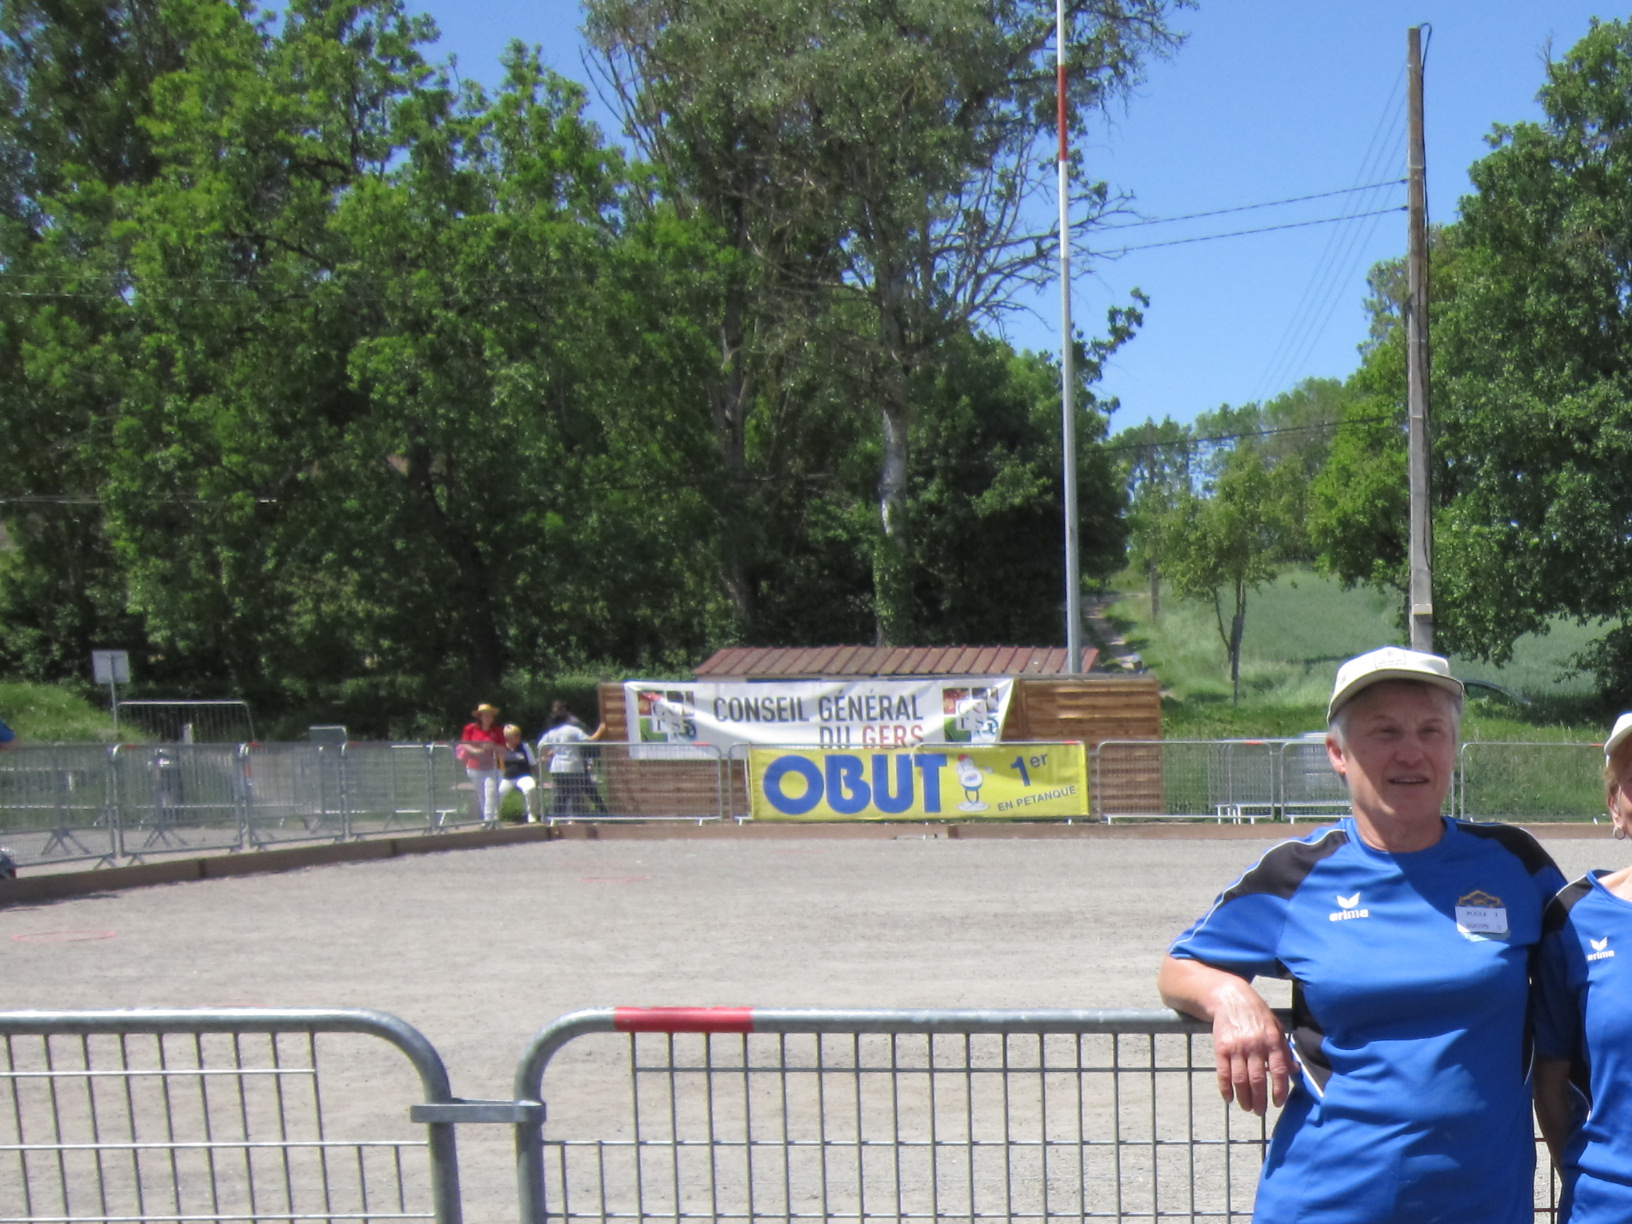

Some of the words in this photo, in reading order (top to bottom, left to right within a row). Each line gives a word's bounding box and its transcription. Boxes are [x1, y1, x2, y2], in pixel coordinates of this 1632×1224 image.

[713, 696, 809, 722] CONSEIL
[818, 688, 924, 721] GÉNÉRAL
[862, 725, 924, 749] GERS
[763, 754, 947, 815] OBUT
[1010, 753, 1048, 787] 1er
[998, 801, 1013, 811] EN
[1016, 786, 1076, 807] PETANQUE
[1329, 909, 1369, 921] erima
